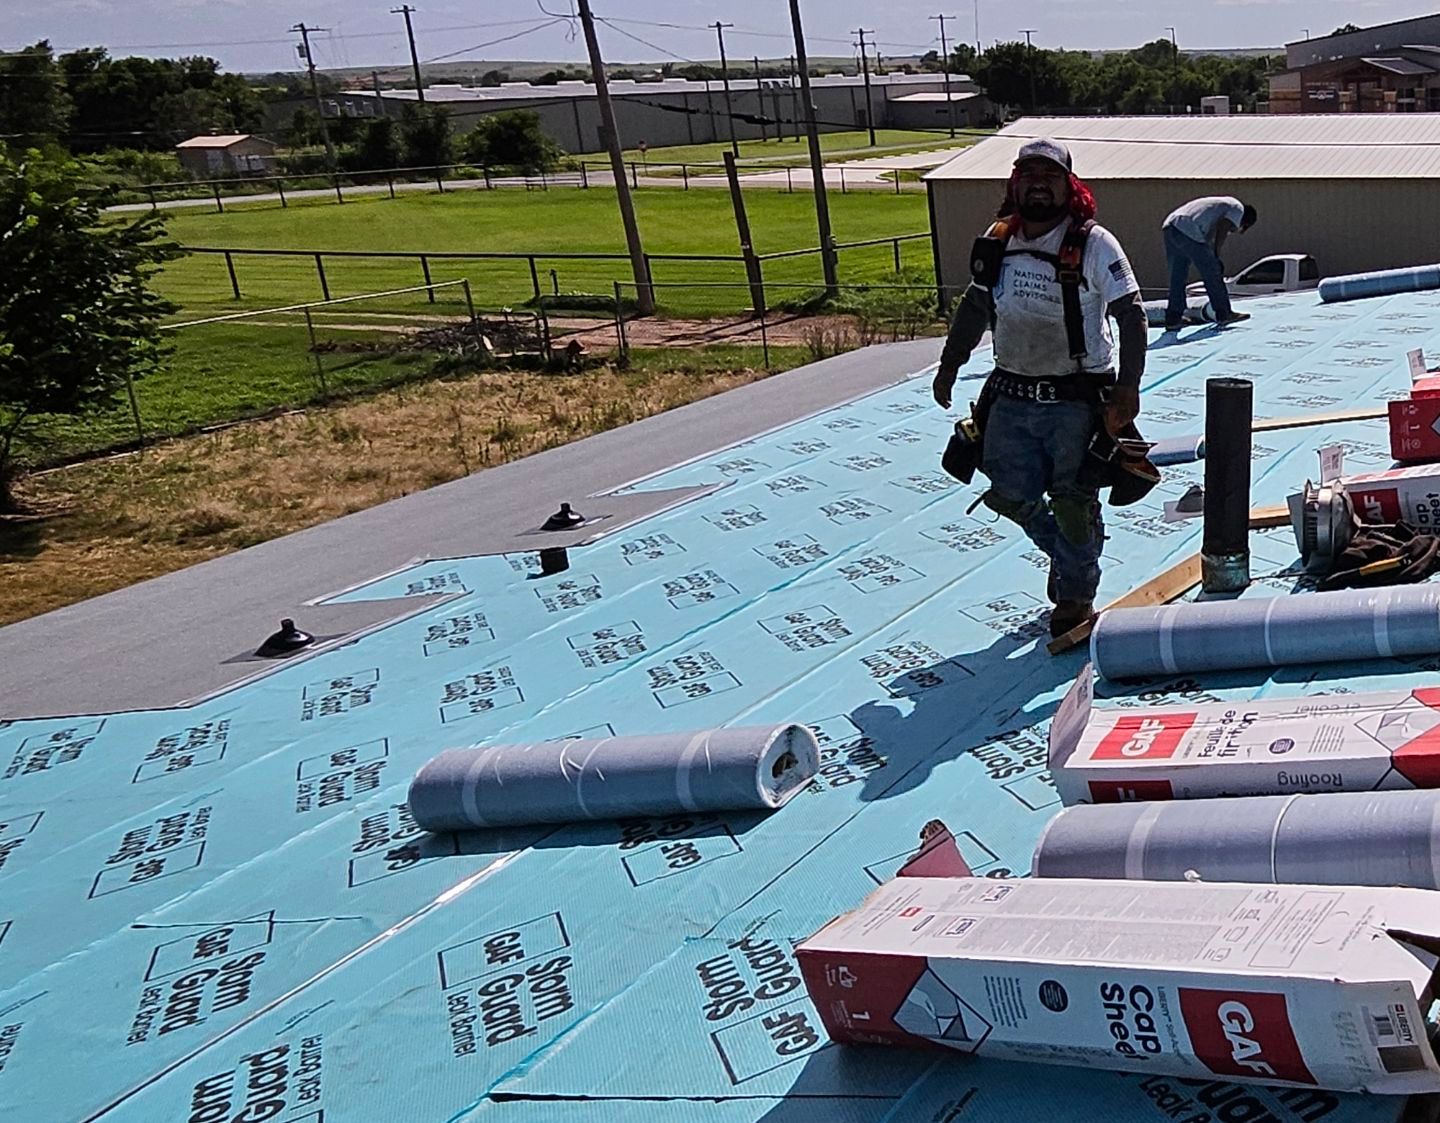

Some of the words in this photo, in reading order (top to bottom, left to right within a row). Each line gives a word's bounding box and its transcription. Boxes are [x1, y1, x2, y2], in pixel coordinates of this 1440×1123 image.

[1013, 279, 1047, 291] CLAIMS
[1014, 269, 1052, 282] NATION
[1121, 719, 1165, 756] GAF
[966, 744, 1026, 780] Storm
[1277, 771, 1343, 787] Roofing
[661, 841, 702, 869] GAF
[193, 927, 234, 960] GAF
[483, 931, 525, 965] GAF
[158, 969, 220, 1036] Guard
[211, 952, 267, 1013] Storm
[525, 956, 575, 1021] Storm
[695, 954, 756, 1021] Storm
[477, 973, 538, 1047] Guard
[1129, 985, 1162, 1053] Cap
[762, 1009, 820, 1056] GAF
[1217, 1001, 1278, 1077] GAF
